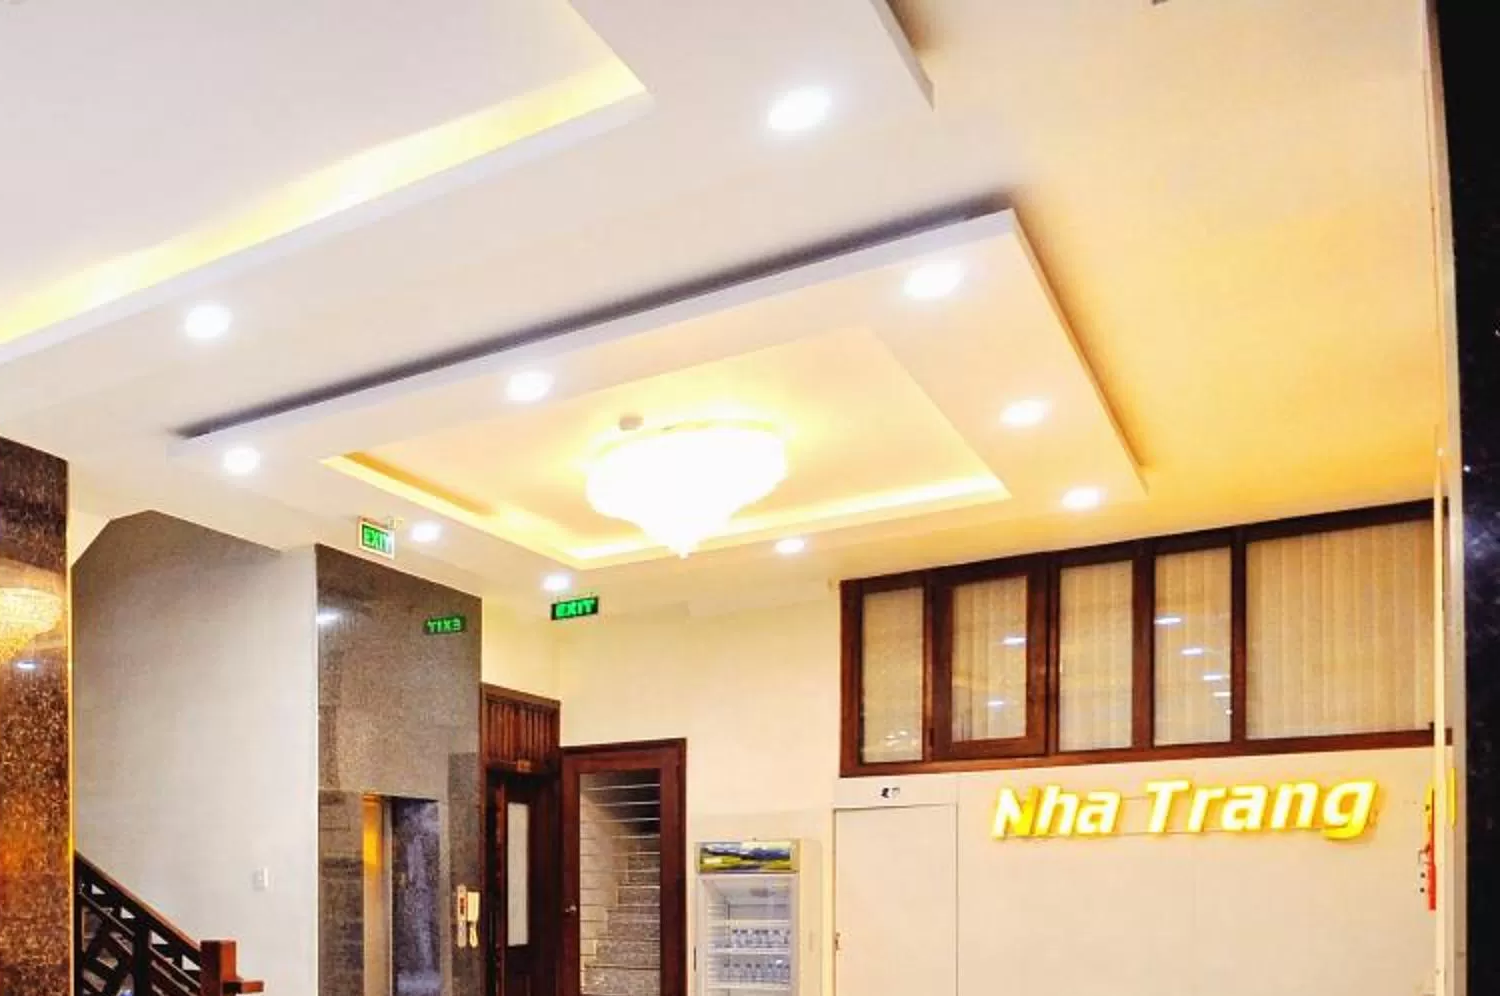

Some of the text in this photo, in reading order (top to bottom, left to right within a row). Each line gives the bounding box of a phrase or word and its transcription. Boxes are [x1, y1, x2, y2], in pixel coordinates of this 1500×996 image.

[363, 526, 392, 551] EXIT
[555, 599, 596, 618] EXIT
[991, 778, 1376, 840] Nha Trang
